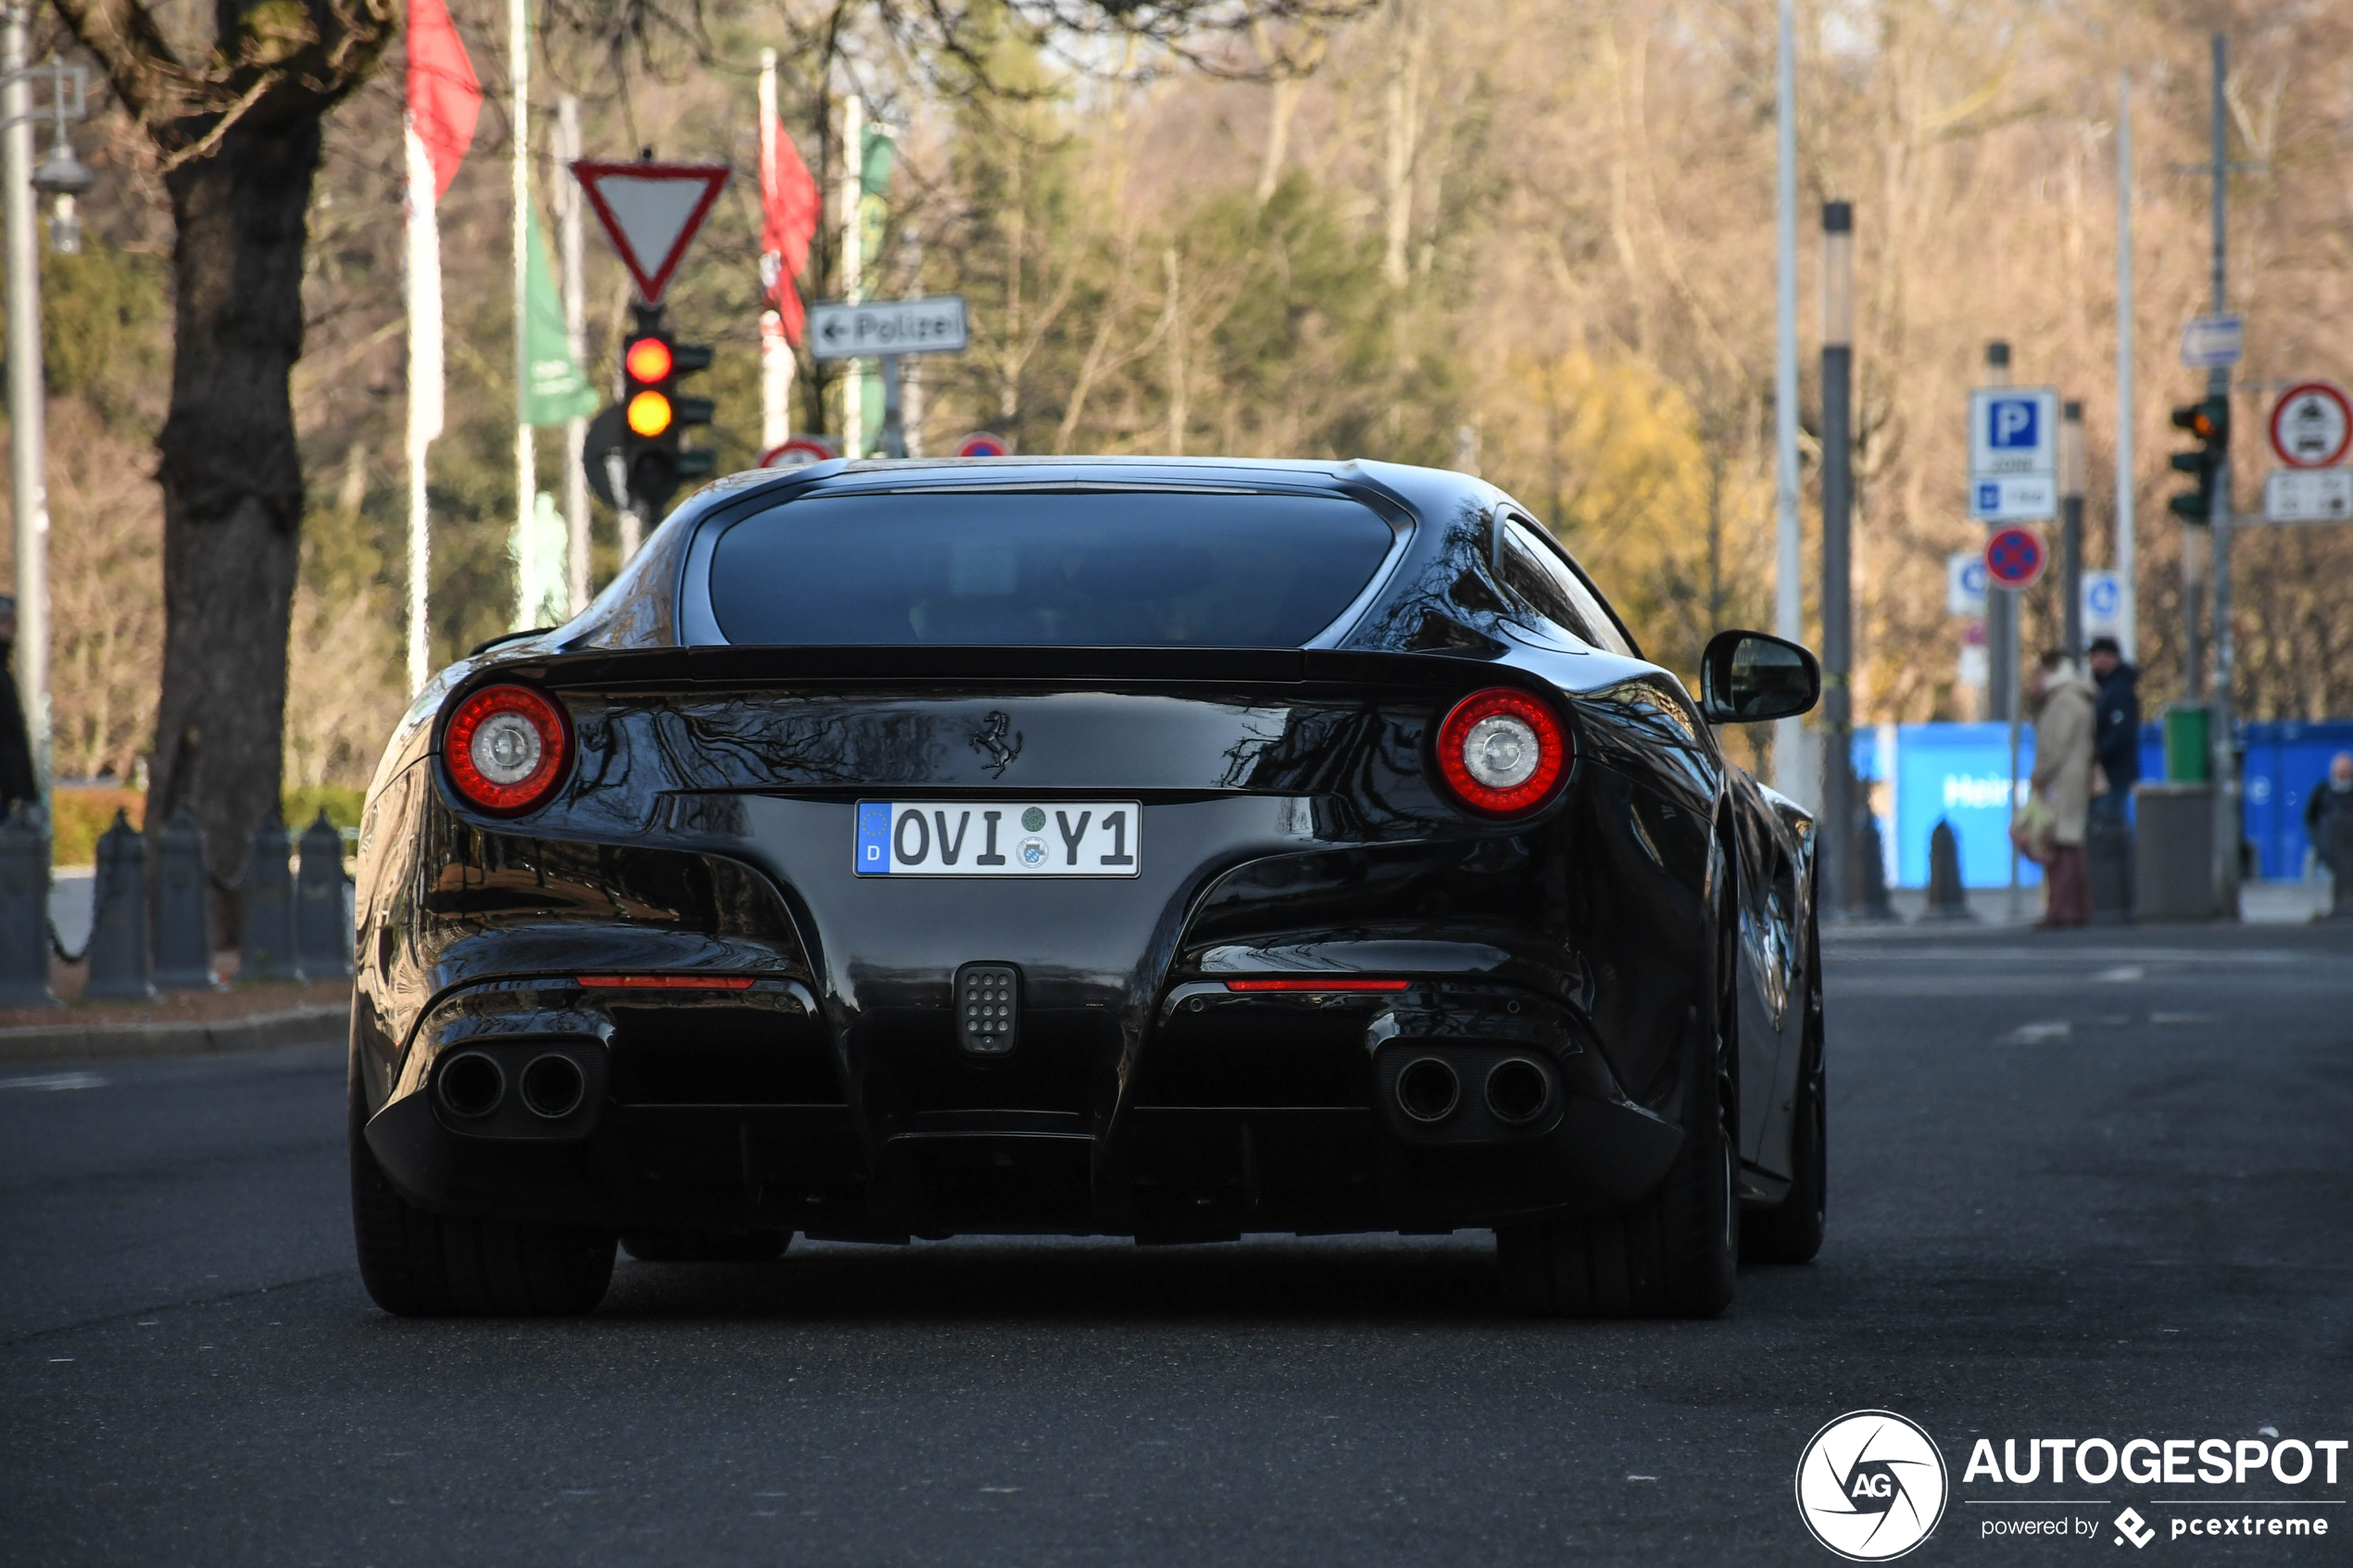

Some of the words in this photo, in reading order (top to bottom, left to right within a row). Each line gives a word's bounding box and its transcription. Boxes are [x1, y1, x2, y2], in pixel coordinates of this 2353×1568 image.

[852, 308, 960, 345] Polizei
[1997, 402, 2031, 445] P
[867, 845, 880, 861] D
[893, 809, 1006, 866] OVI
[1055, 810, 1134, 866] Y1
